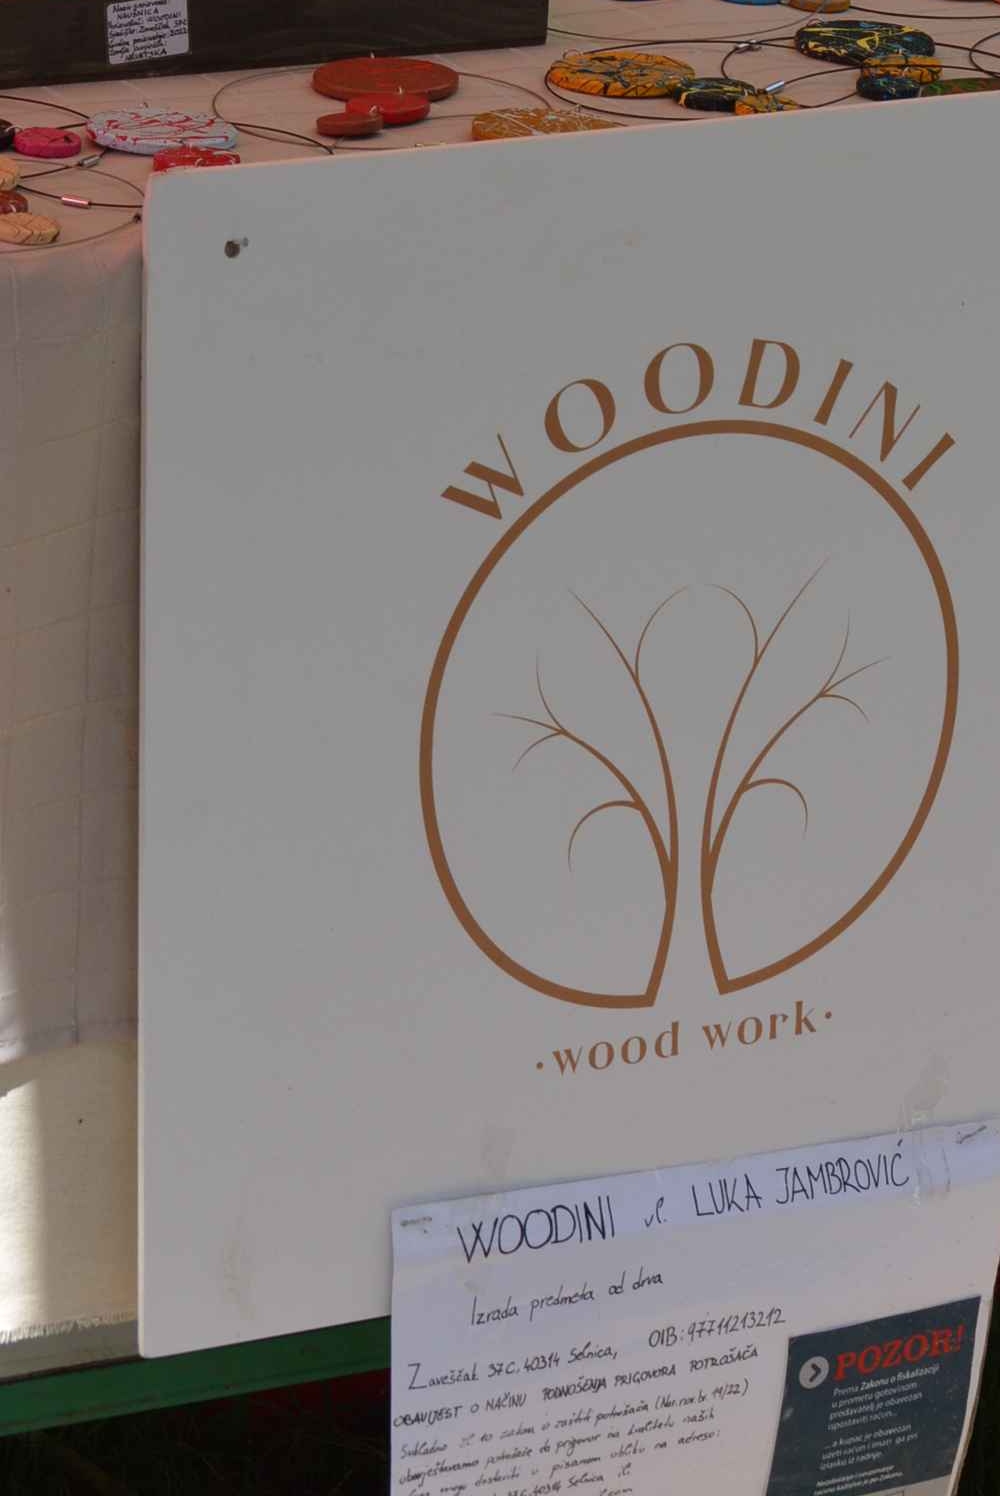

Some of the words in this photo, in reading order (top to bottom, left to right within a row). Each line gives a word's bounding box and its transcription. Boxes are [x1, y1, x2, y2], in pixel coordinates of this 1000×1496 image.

[441, 338, 957, 520] WOODINI
[457, 1195, 614, 1264] WOODINI
[691, 1173, 763, 1217] LUKA
[775, 1138, 911, 1206] JAMBROVIĆ
[471, 1295, 519, 1326] Izrada
[529, 1280, 595, 1323] predmeta
[608, 1270, 626, 1296] od
[632, 1265, 664, 1291] drva
[832, 1322, 966, 1382] POZOR!
[485, 1391, 527, 1413] NAČINU
